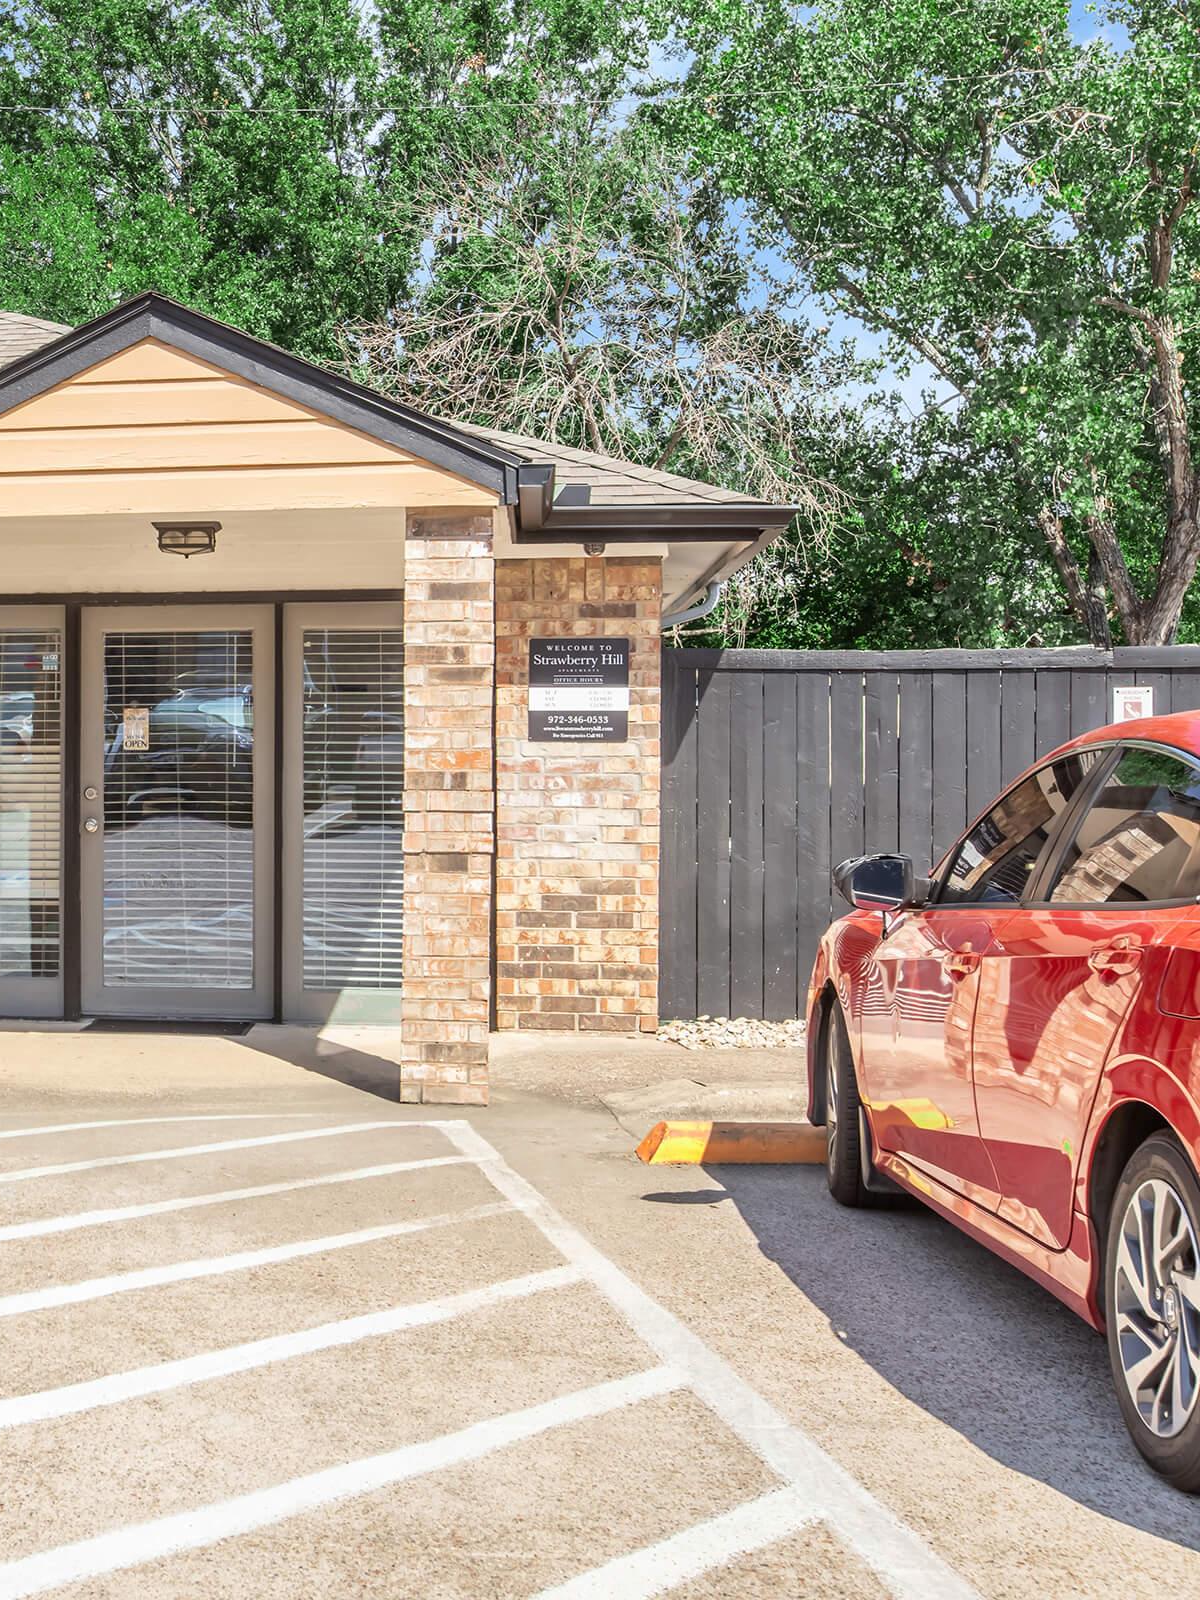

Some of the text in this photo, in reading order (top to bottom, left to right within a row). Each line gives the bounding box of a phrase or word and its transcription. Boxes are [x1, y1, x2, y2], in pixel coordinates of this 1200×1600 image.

[533, 653, 624, 668] Strawberry Hill
[548, 715, 609, 724] 972-346-0533
[125, 740, 147, 748] OPEN
